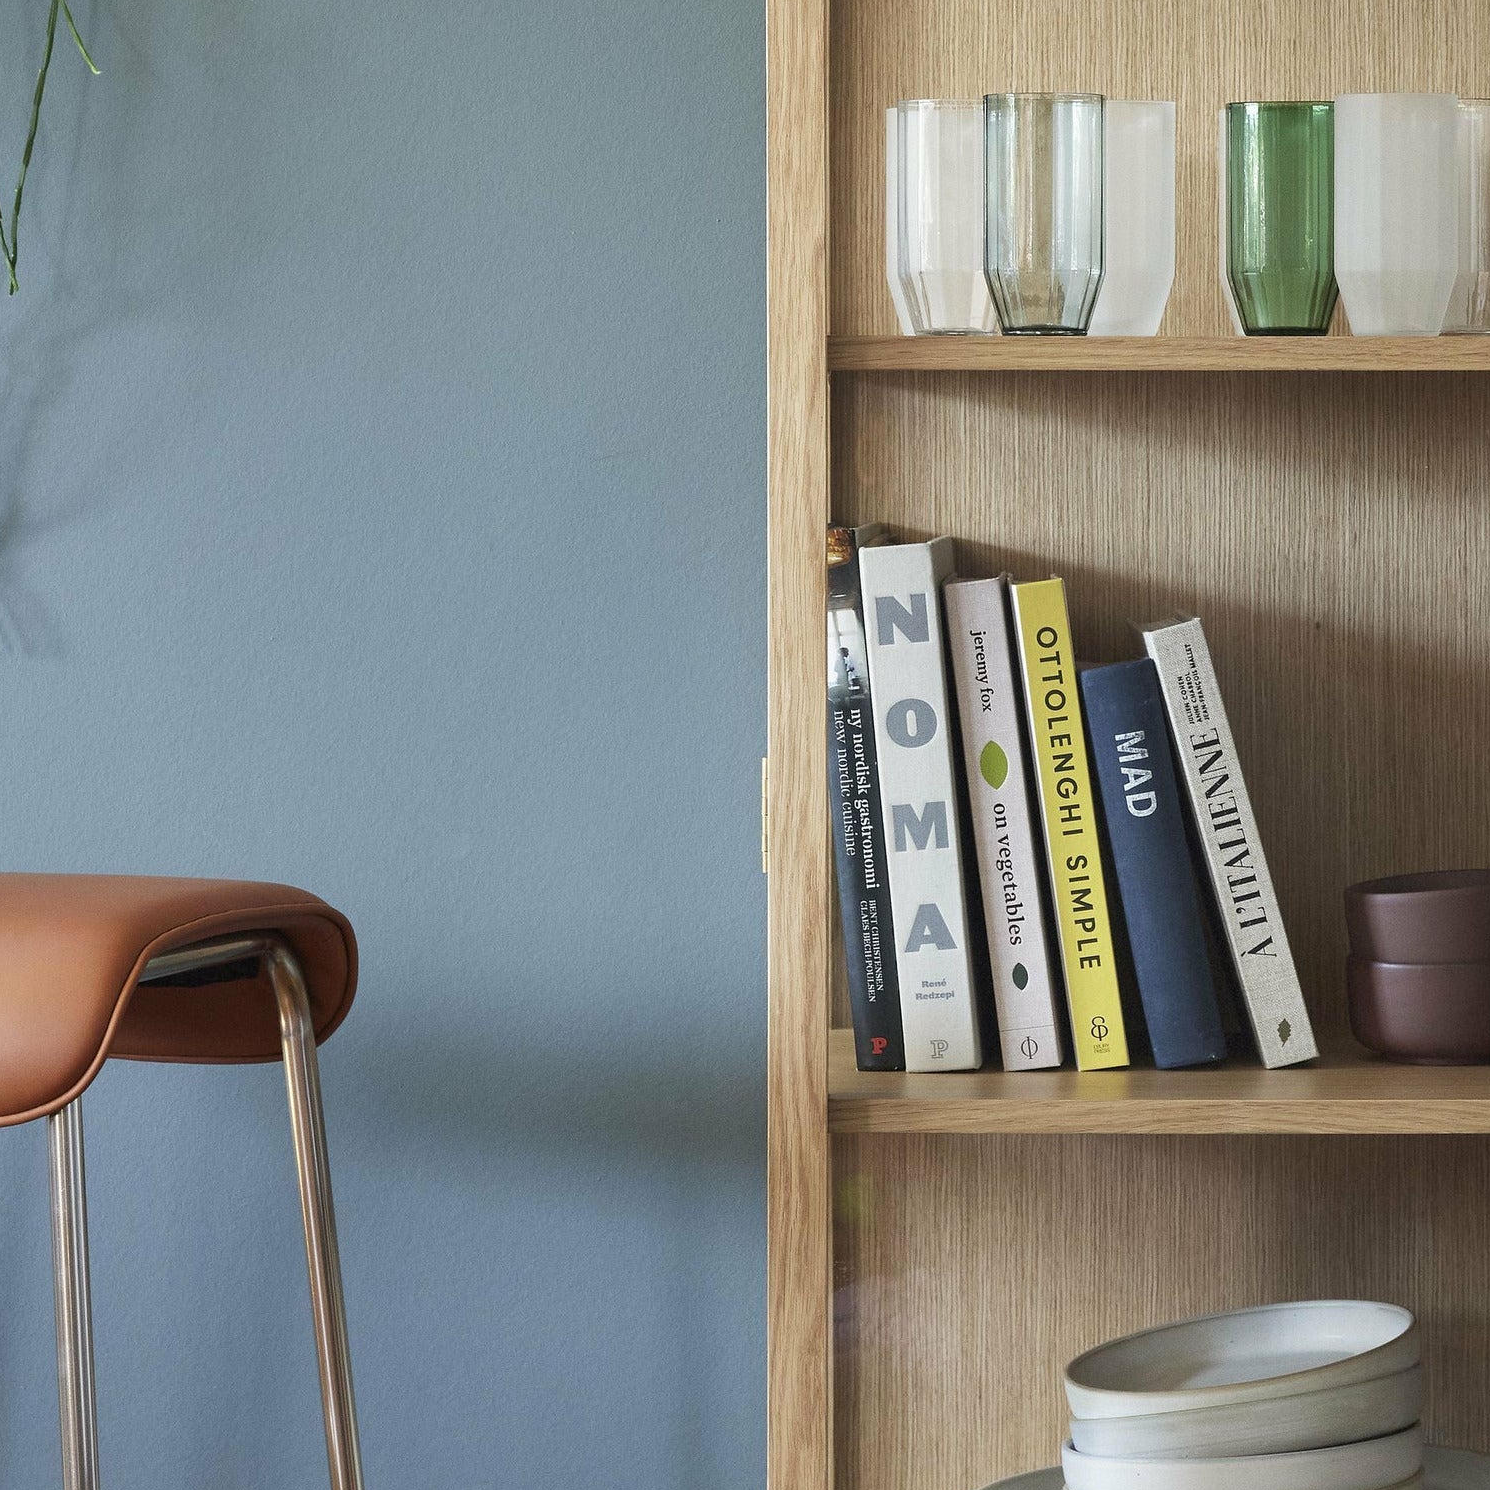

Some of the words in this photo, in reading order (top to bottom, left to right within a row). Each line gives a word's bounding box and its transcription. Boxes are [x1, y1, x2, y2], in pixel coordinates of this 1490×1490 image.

[969, 630, 989, 684] jeremy
[980, 688, 994, 712] fox
[1184, 643, 1196, 669] MALLET
[1177, 675, 1188, 701] COHEN
[1184, 671, 1197, 703] CHABROL
[833, 710, 846, 744] new
[846, 708, 862, 729] ny
[1184, 702, 1195, 724] JULIEN
[1192, 704, 1203, 723] ANNE
[837, 748, 854, 797] nordic
[852, 733, 872, 795] nordisk
[875, 593, 958, 954] NOMA
[1114, 730, 1158, 818] MAD
[1036, 626, 1084, 836] OTTOLENGHI
[1066, 855, 1102, 970] SIMPLE
[841, 801, 858, 856] cuisine
[993, 803, 1008, 829] on
[1189, 727, 1268, 930] L'ITALIENNE
[853, 798, 881, 889] gastronomi
[996, 834, 1025, 946] vegetables
[860, 900, 870, 931] CLAES
[869, 899, 878, 925] BENT
[871, 926, 884, 991] CHRISTENSEN
[1240, 935, 1277, 958] À
[862, 931, 876, 1002] BECH-POULSEN
[915, 990, 955, 1000] Redzepi
[921, 978, 947, 988] René
[870, 1037, 888, 1054] P
[930, 1039, 949, 1059] P
